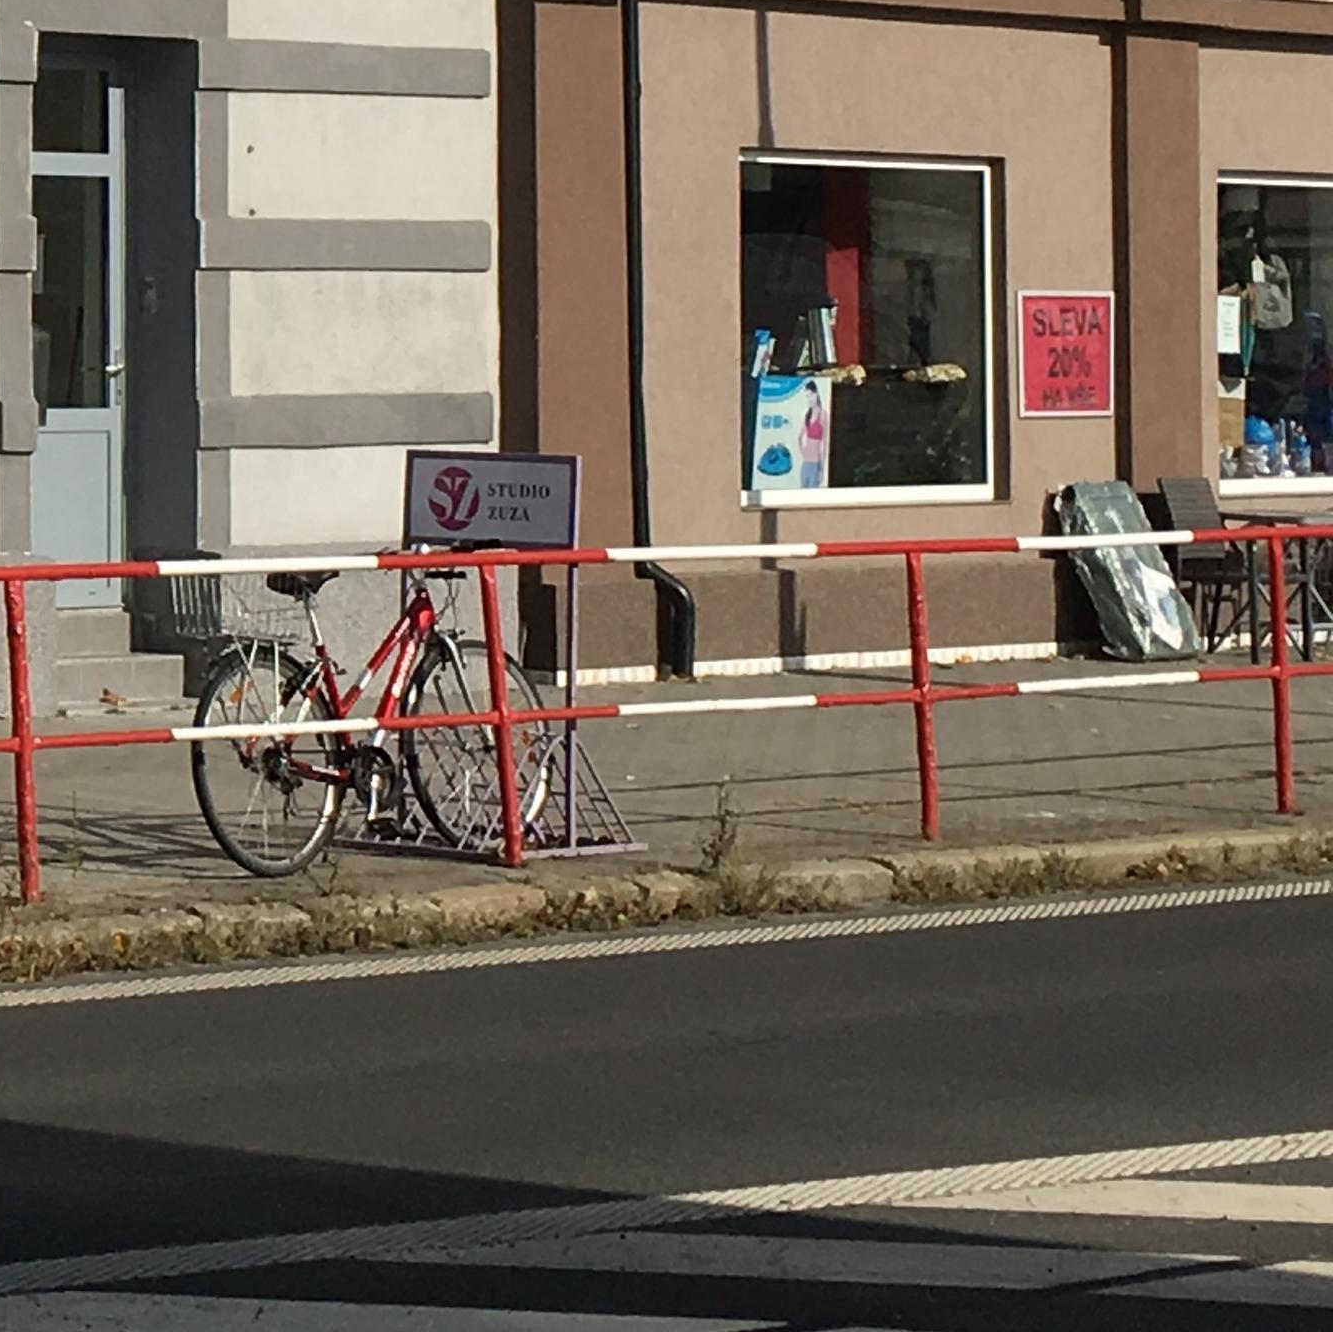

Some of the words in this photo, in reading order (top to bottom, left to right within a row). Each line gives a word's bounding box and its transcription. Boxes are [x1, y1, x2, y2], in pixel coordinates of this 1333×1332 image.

[1033, 307, 1102, 337] SLEVA
[1047, 346, 1092, 378] 20%
[487, 483, 550, 499] STUDIO
[487, 506, 530, 522] ZUZA
